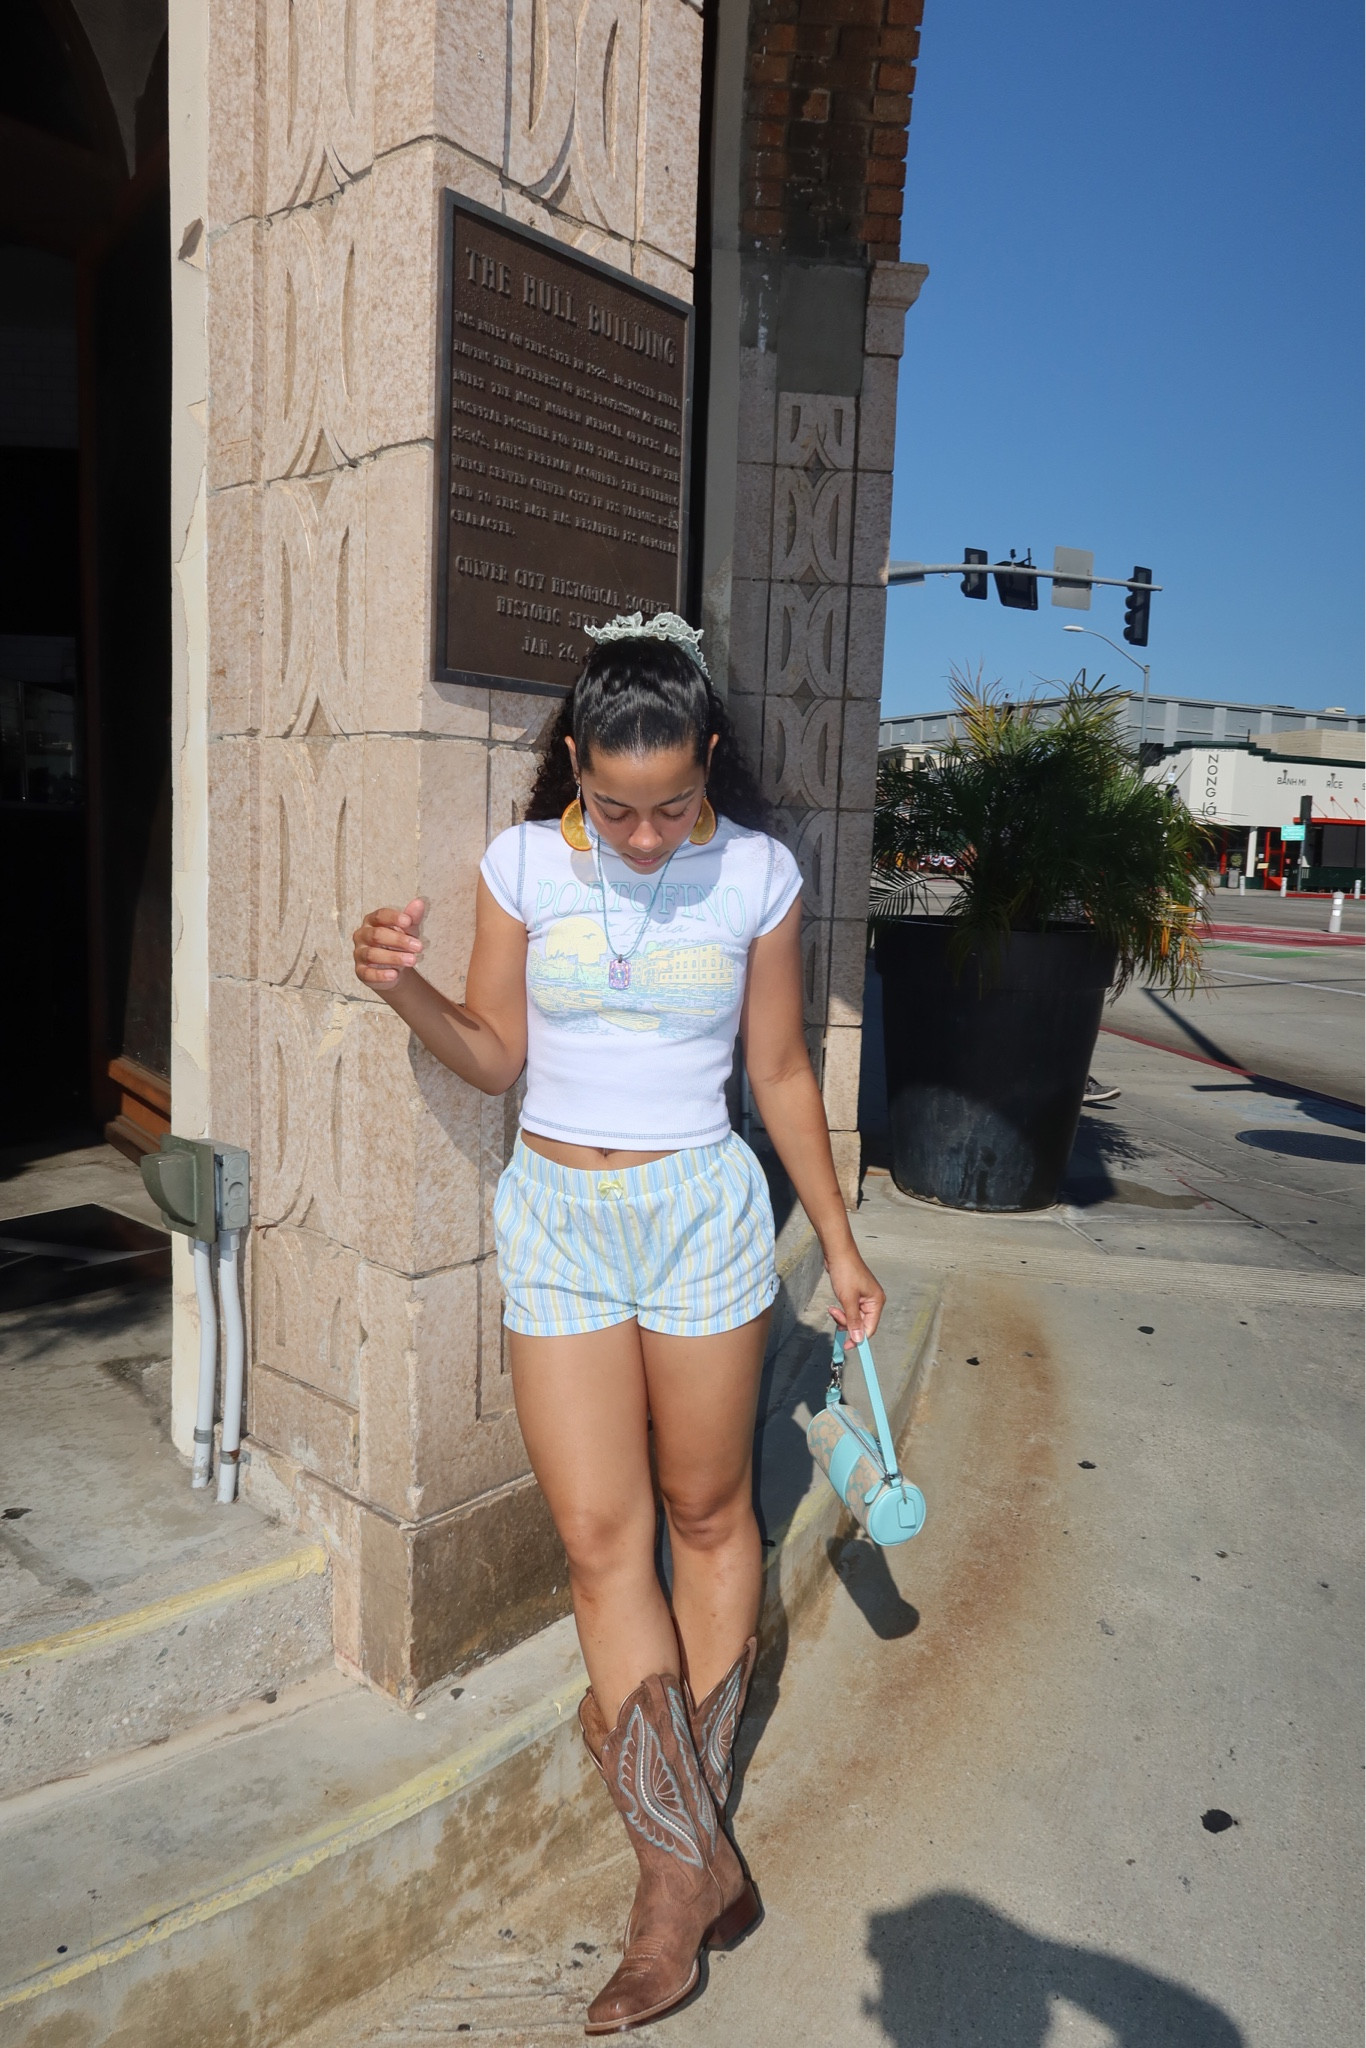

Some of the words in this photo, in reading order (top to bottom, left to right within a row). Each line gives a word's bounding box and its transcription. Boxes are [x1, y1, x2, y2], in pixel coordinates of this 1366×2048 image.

[466, 247, 511, 295] THE
[523, 272, 578, 323] HULL
[587, 300, 676, 364] BUILDING
[477, 319, 507, 340] BUILT
[510, 332, 523, 345] ON
[525, 338, 548, 355] THIS
[550, 348, 571, 365] SITE
[574, 355, 584, 370] IN
[453, 341, 491, 362] HAVING
[494, 355, 512, 370] THE
[515, 363, 561, 388] INTEREST
[653, 416, 680, 436] HEART,
[453, 368, 486, 389] BUILT
[491, 382, 511, 397] THE
[515, 391, 541, 408] MOST
[544, 402, 582, 423] MODERN
[585, 413, 623, 438] MEDICAL
[626, 431, 660, 451] OFFICES
[664, 443, 680, 457] AND
[453, 397, 501, 423] HOSPITAL
[504, 415, 550, 439] POSSIBLE
[552, 431, 569, 444] FOR
[572, 435, 595, 453] THAT
[663, 468, 680, 482] THE
[451, 454, 486, 473] WHICH
[489, 466, 527, 485] SERVED
[530, 477, 566, 496] CULVER
[568, 489, 591, 504] CITY
[605, 497, 621, 512] ITS
[621, 503, 656, 523] VARIOUS
[494, 439, 525, 457] LOUIS
[528, 450, 572, 472] FREEMAN
[574, 464, 619, 488] ACQUIRED
[621, 479, 638, 494] THE
[639, 486, 679, 506] BUILDING
[451, 482, 473, 498] AND
[478, 490, 491, 502] TO
[496, 495, 521, 510] THIS
[525, 502, 549, 518] DATE
[553, 511, 571, 524] HAS
[574, 516, 620, 540] RETAINED
[623, 531, 638, 544] ITS
[639, 536, 679, 555] ORIGINAL
[455, 555, 508, 582] CULVER
[514, 569, 545, 590] CITY
[551, 577, 621, 607] HISTORICAL
[497, 596, 561, 624] HISTORIC
[568, 611, 598, 629] SITE
[522, 636, 552, 656] JAN.
[558, 642, 579, 664] 26,
[1206, 754, 1219, 797] NONG
[1327, 780, 1343, 789] RICE
[534, 878, 747, 937] PORTOFINO
